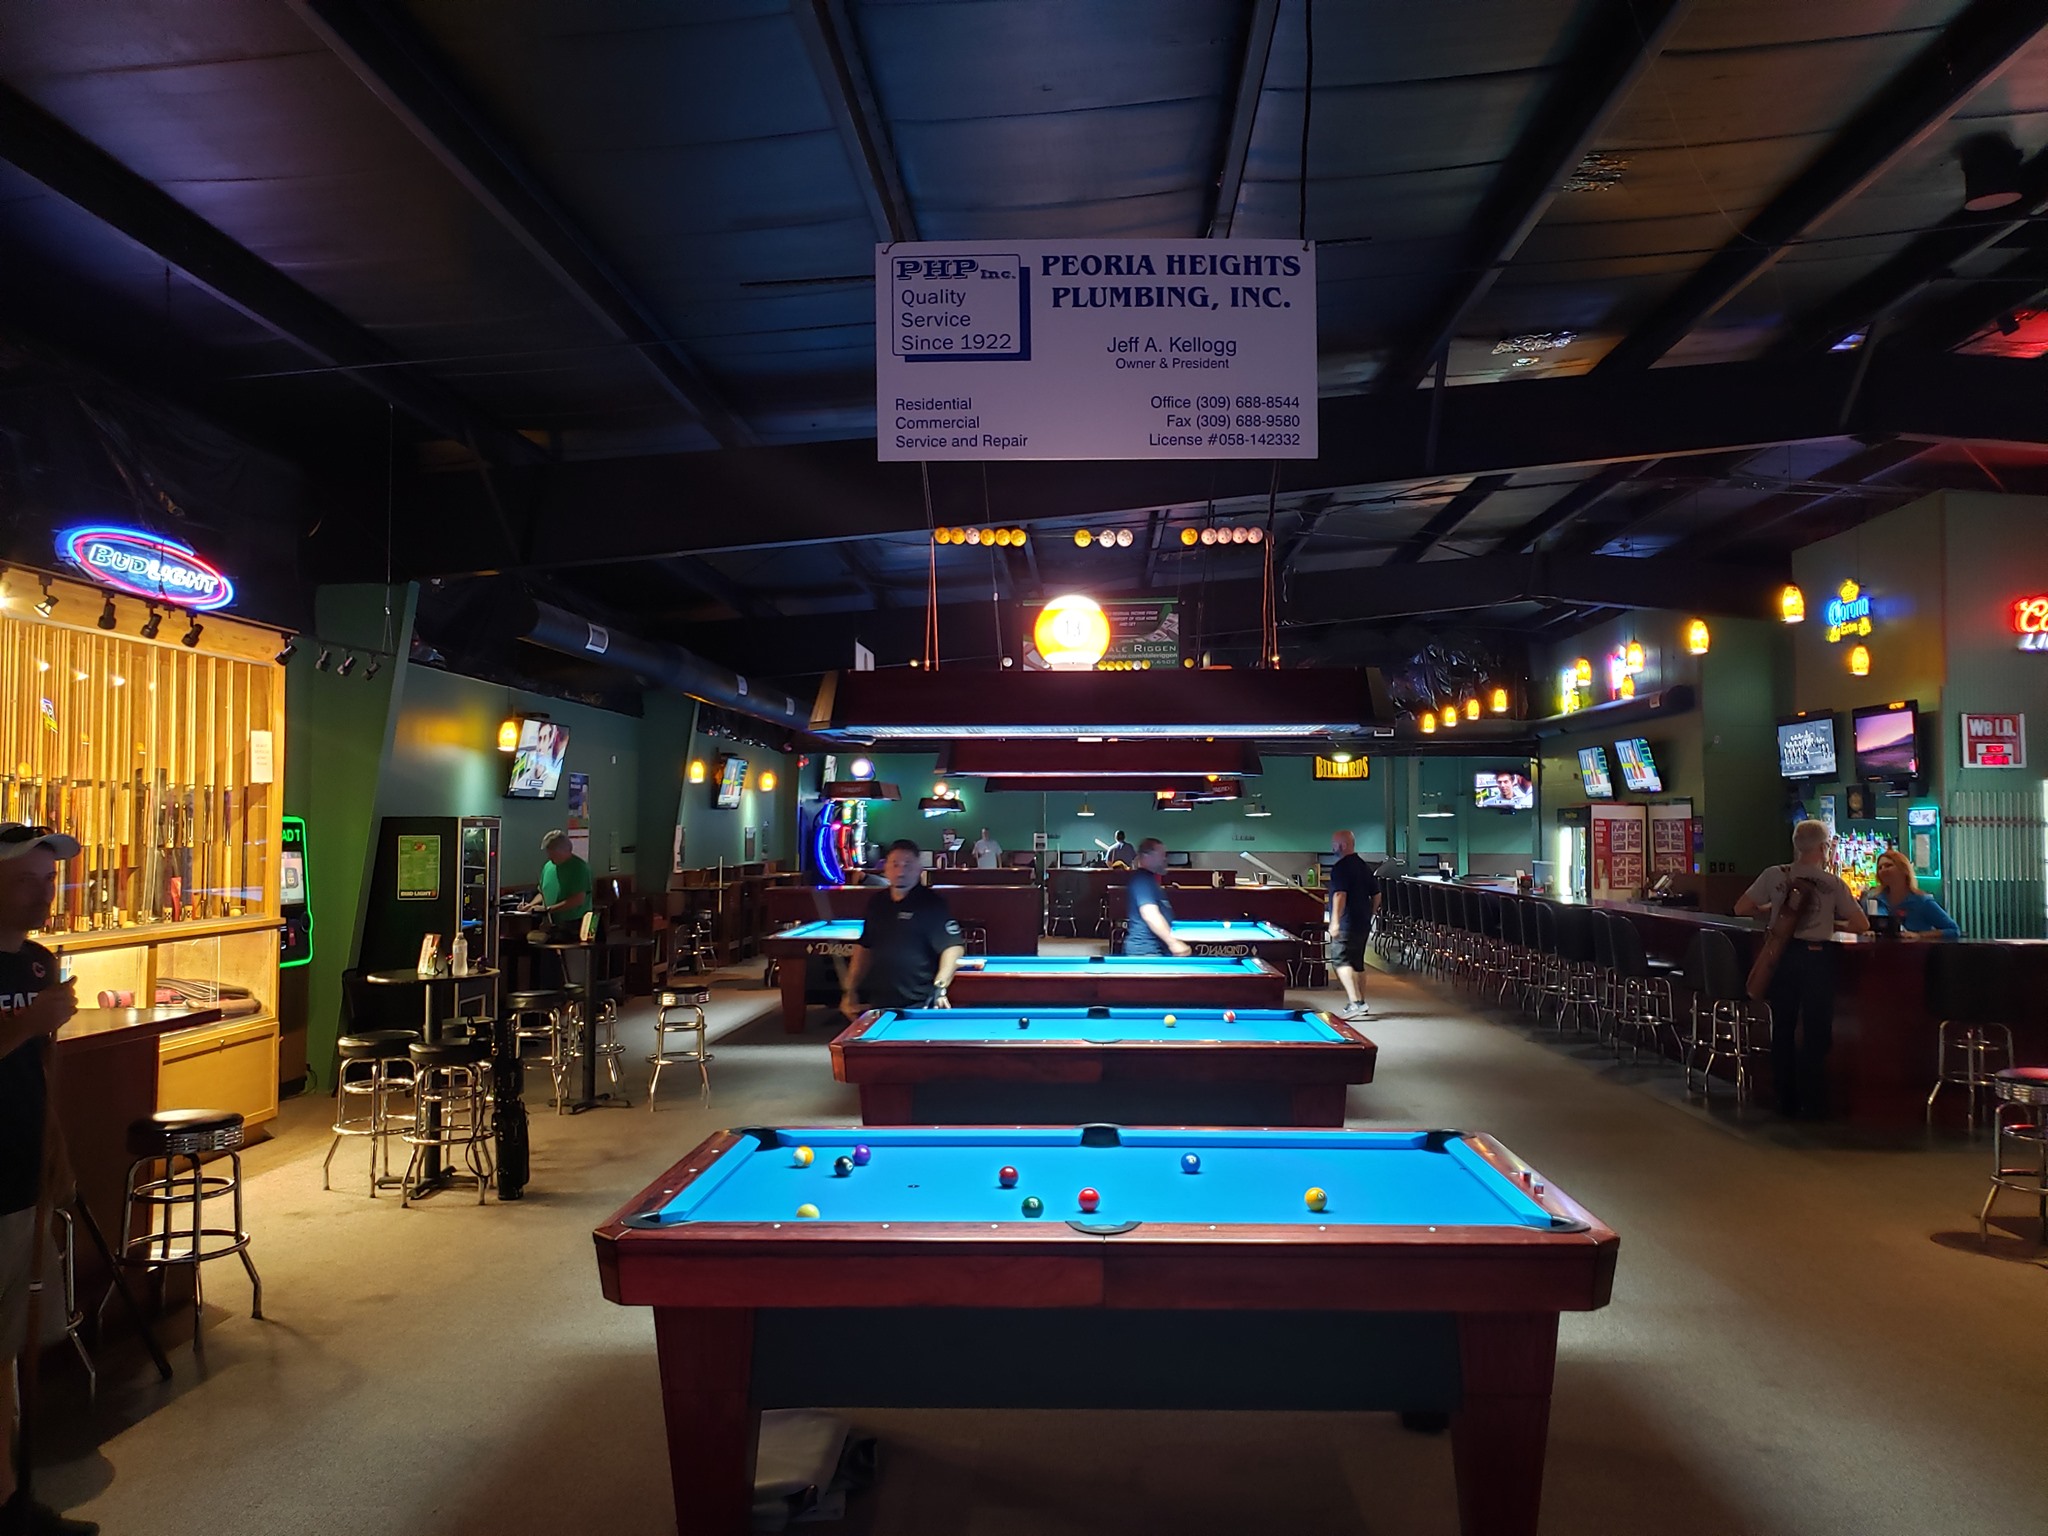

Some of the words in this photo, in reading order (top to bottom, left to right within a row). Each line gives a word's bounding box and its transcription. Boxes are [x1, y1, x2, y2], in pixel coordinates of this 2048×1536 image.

[897, 259, 979, 280] PHP
[980, 269, 1016, 279] Inc.
[1041, 254, 1156, 276] PEORIA
[1166, 254, 1301, 276] HEIGHTS
[902, 289, 966, 308] Quality
[1052, 286, 1219, 311] PLUMBING,
[1230, 286, 1291, 309] INC.
[901, 312, 971, 328] Service
[902, 335, 954, 350] Since
[961, 334, 1012, 350] 1922
[1107, 336, 1140, 353] Jeff
[1144, 337, 1162, 353] A.
[1169, 336, 1237, 356] Kellogg
[1115, 358, 1156, 369] Owner
[1159, 357, 1169, 369] &
[1172, 357, 1230, 369] President
[896, 397, 972, 411] Residential
[1151, 395, 1191, 409] Office
[1196, 395, 1231, 411] (309)
[1236, 395, 1300, 409] 688-8544
[896, 416, 979, 430] Commercial
[1167, 414, 1191, 428] Fax
[1196, 414, 1231, 430] (309)
[1236, 414, 1300, 428] 688-9580
[896, 434, 947, 448] Service
[951, 434, 978, 448] and
[982, 434, 1028, 450] Repair
[1150, 433, 1203, 446] License
[1208, 433, 1300, 446] #058-142332
[89, 543, 149, 575] BUD
[148, 559, 219, 594] LIGHT
[1828, 597, 1870, 628] Corona
[1969, 719, 1993, 736] We
[1315, 755, 1369, 778] BILLIARDS
[1195, 944, 1249, 957] DIAMOND
